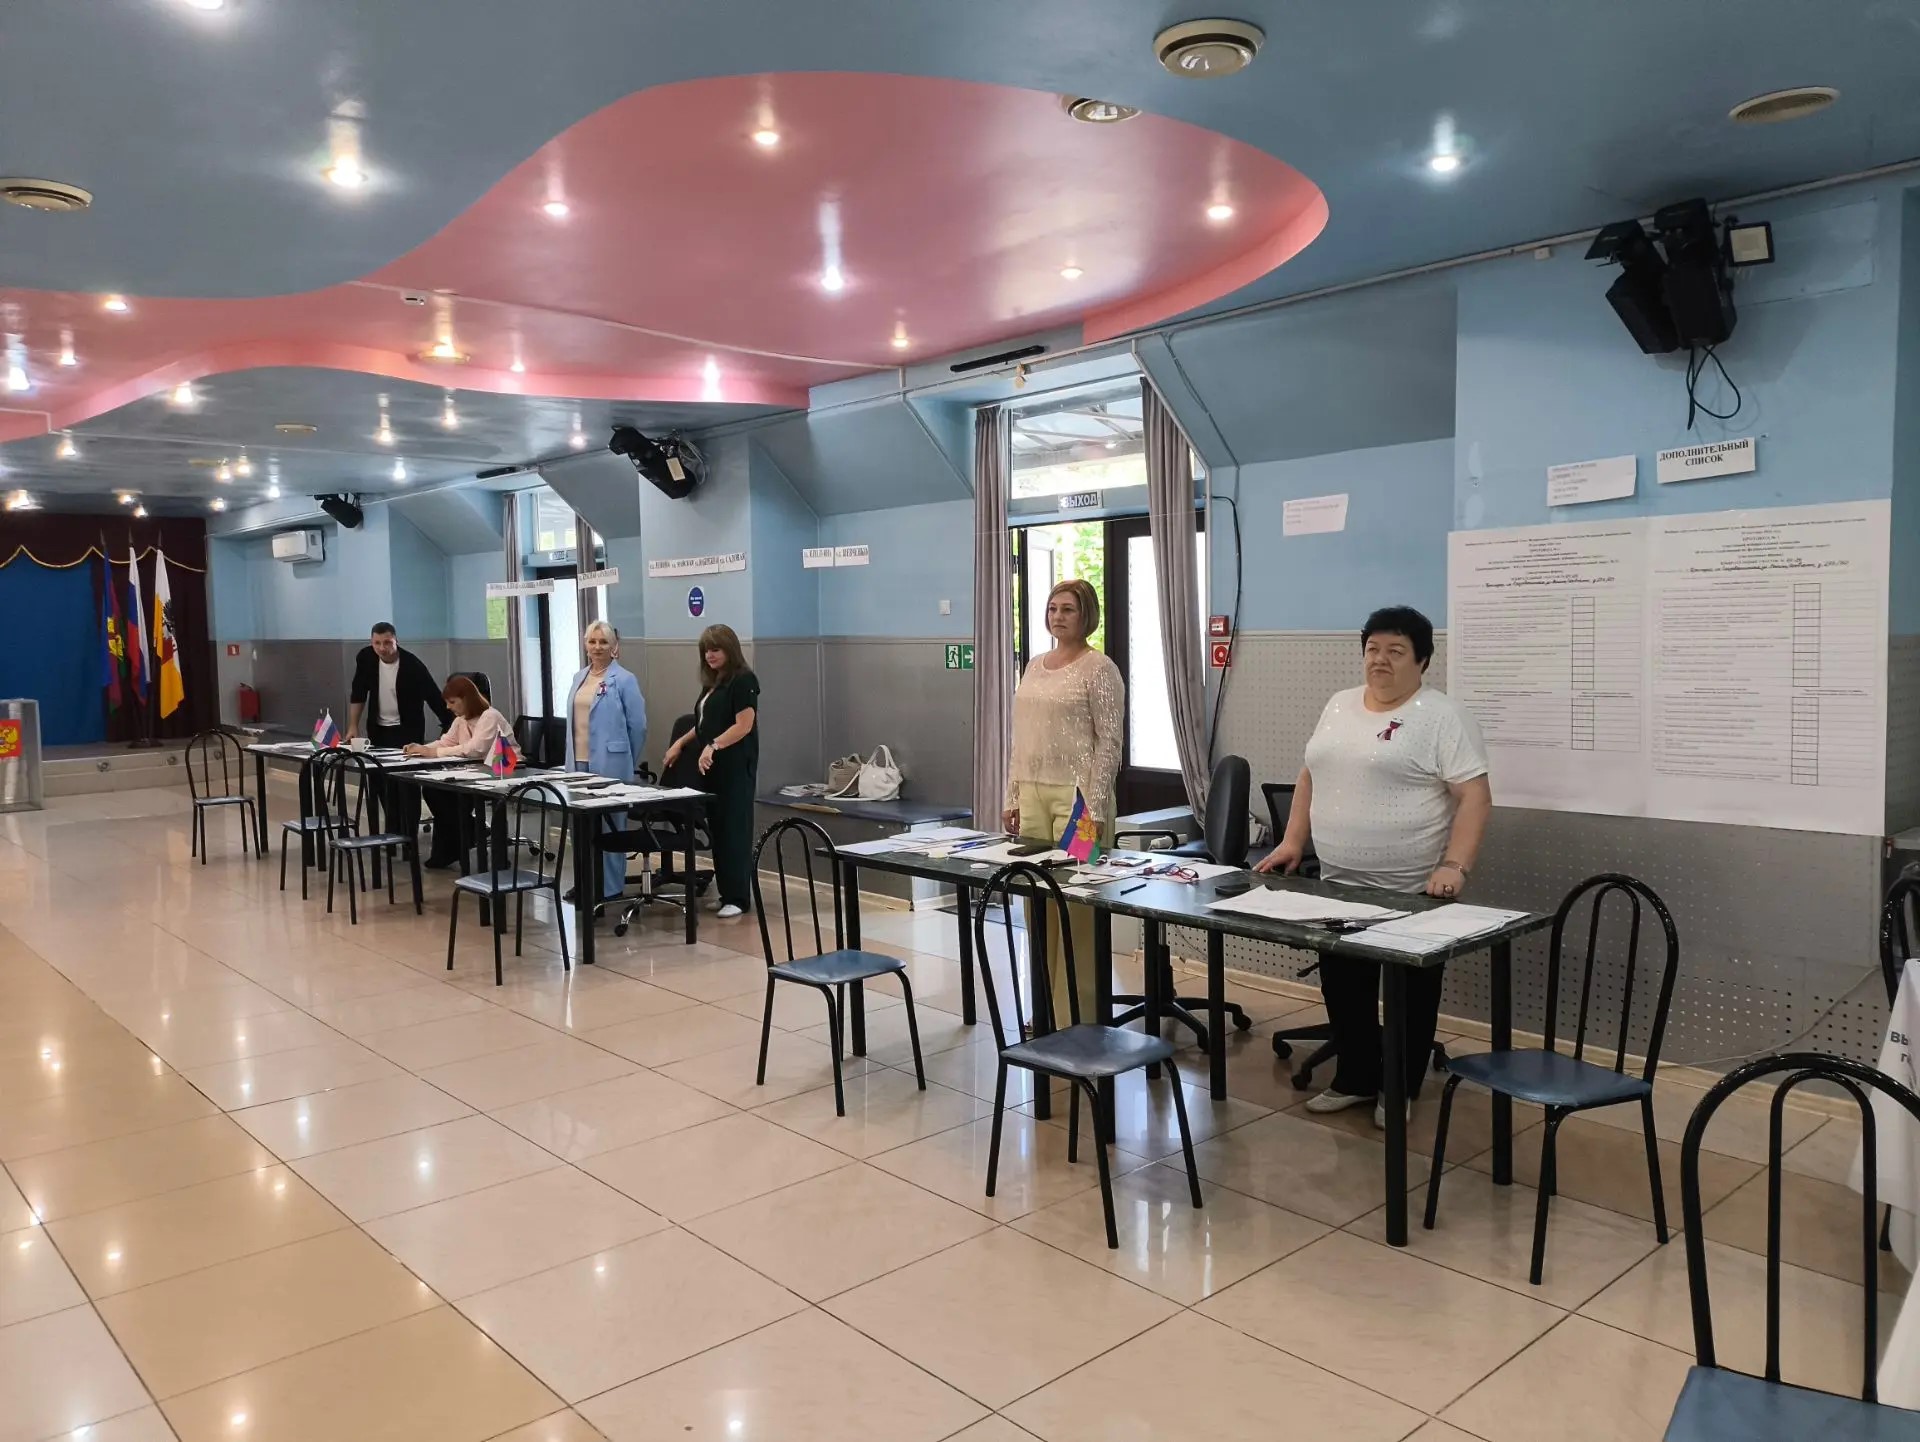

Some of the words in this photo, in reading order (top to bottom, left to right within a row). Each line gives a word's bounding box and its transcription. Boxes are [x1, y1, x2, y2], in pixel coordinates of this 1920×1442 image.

[1659, 440, 1749, 461] ДОПОЛНИТЕЛЬНЫЙ
[1685, 454, 1724, 467] СПИСОК
[1060, 493, 1098, 508] ВЫХОД
